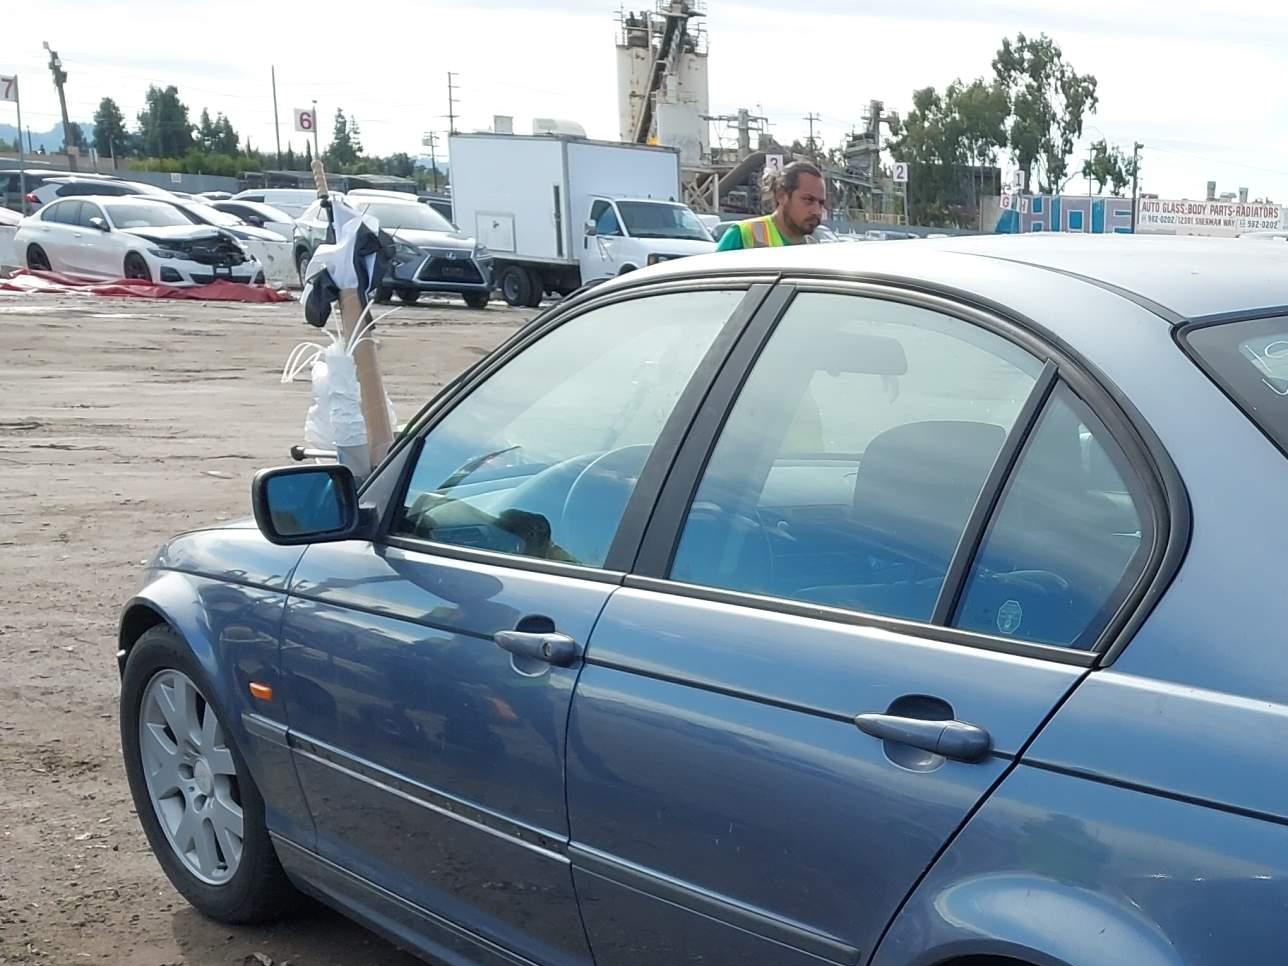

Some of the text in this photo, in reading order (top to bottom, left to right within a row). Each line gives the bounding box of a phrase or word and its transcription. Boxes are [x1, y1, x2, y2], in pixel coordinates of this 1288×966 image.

[1, 78, 14, 98] 7
[299, 112, 311, 130] 6
[896, 165, 904, 179] 2
[1016, 173, 1022, 186] 1
[1142, 202, 1160, 213] AUTO
[1195, 216, 1222, 226] SHERMAN
[1223, 217, 1235, 227] WAY
